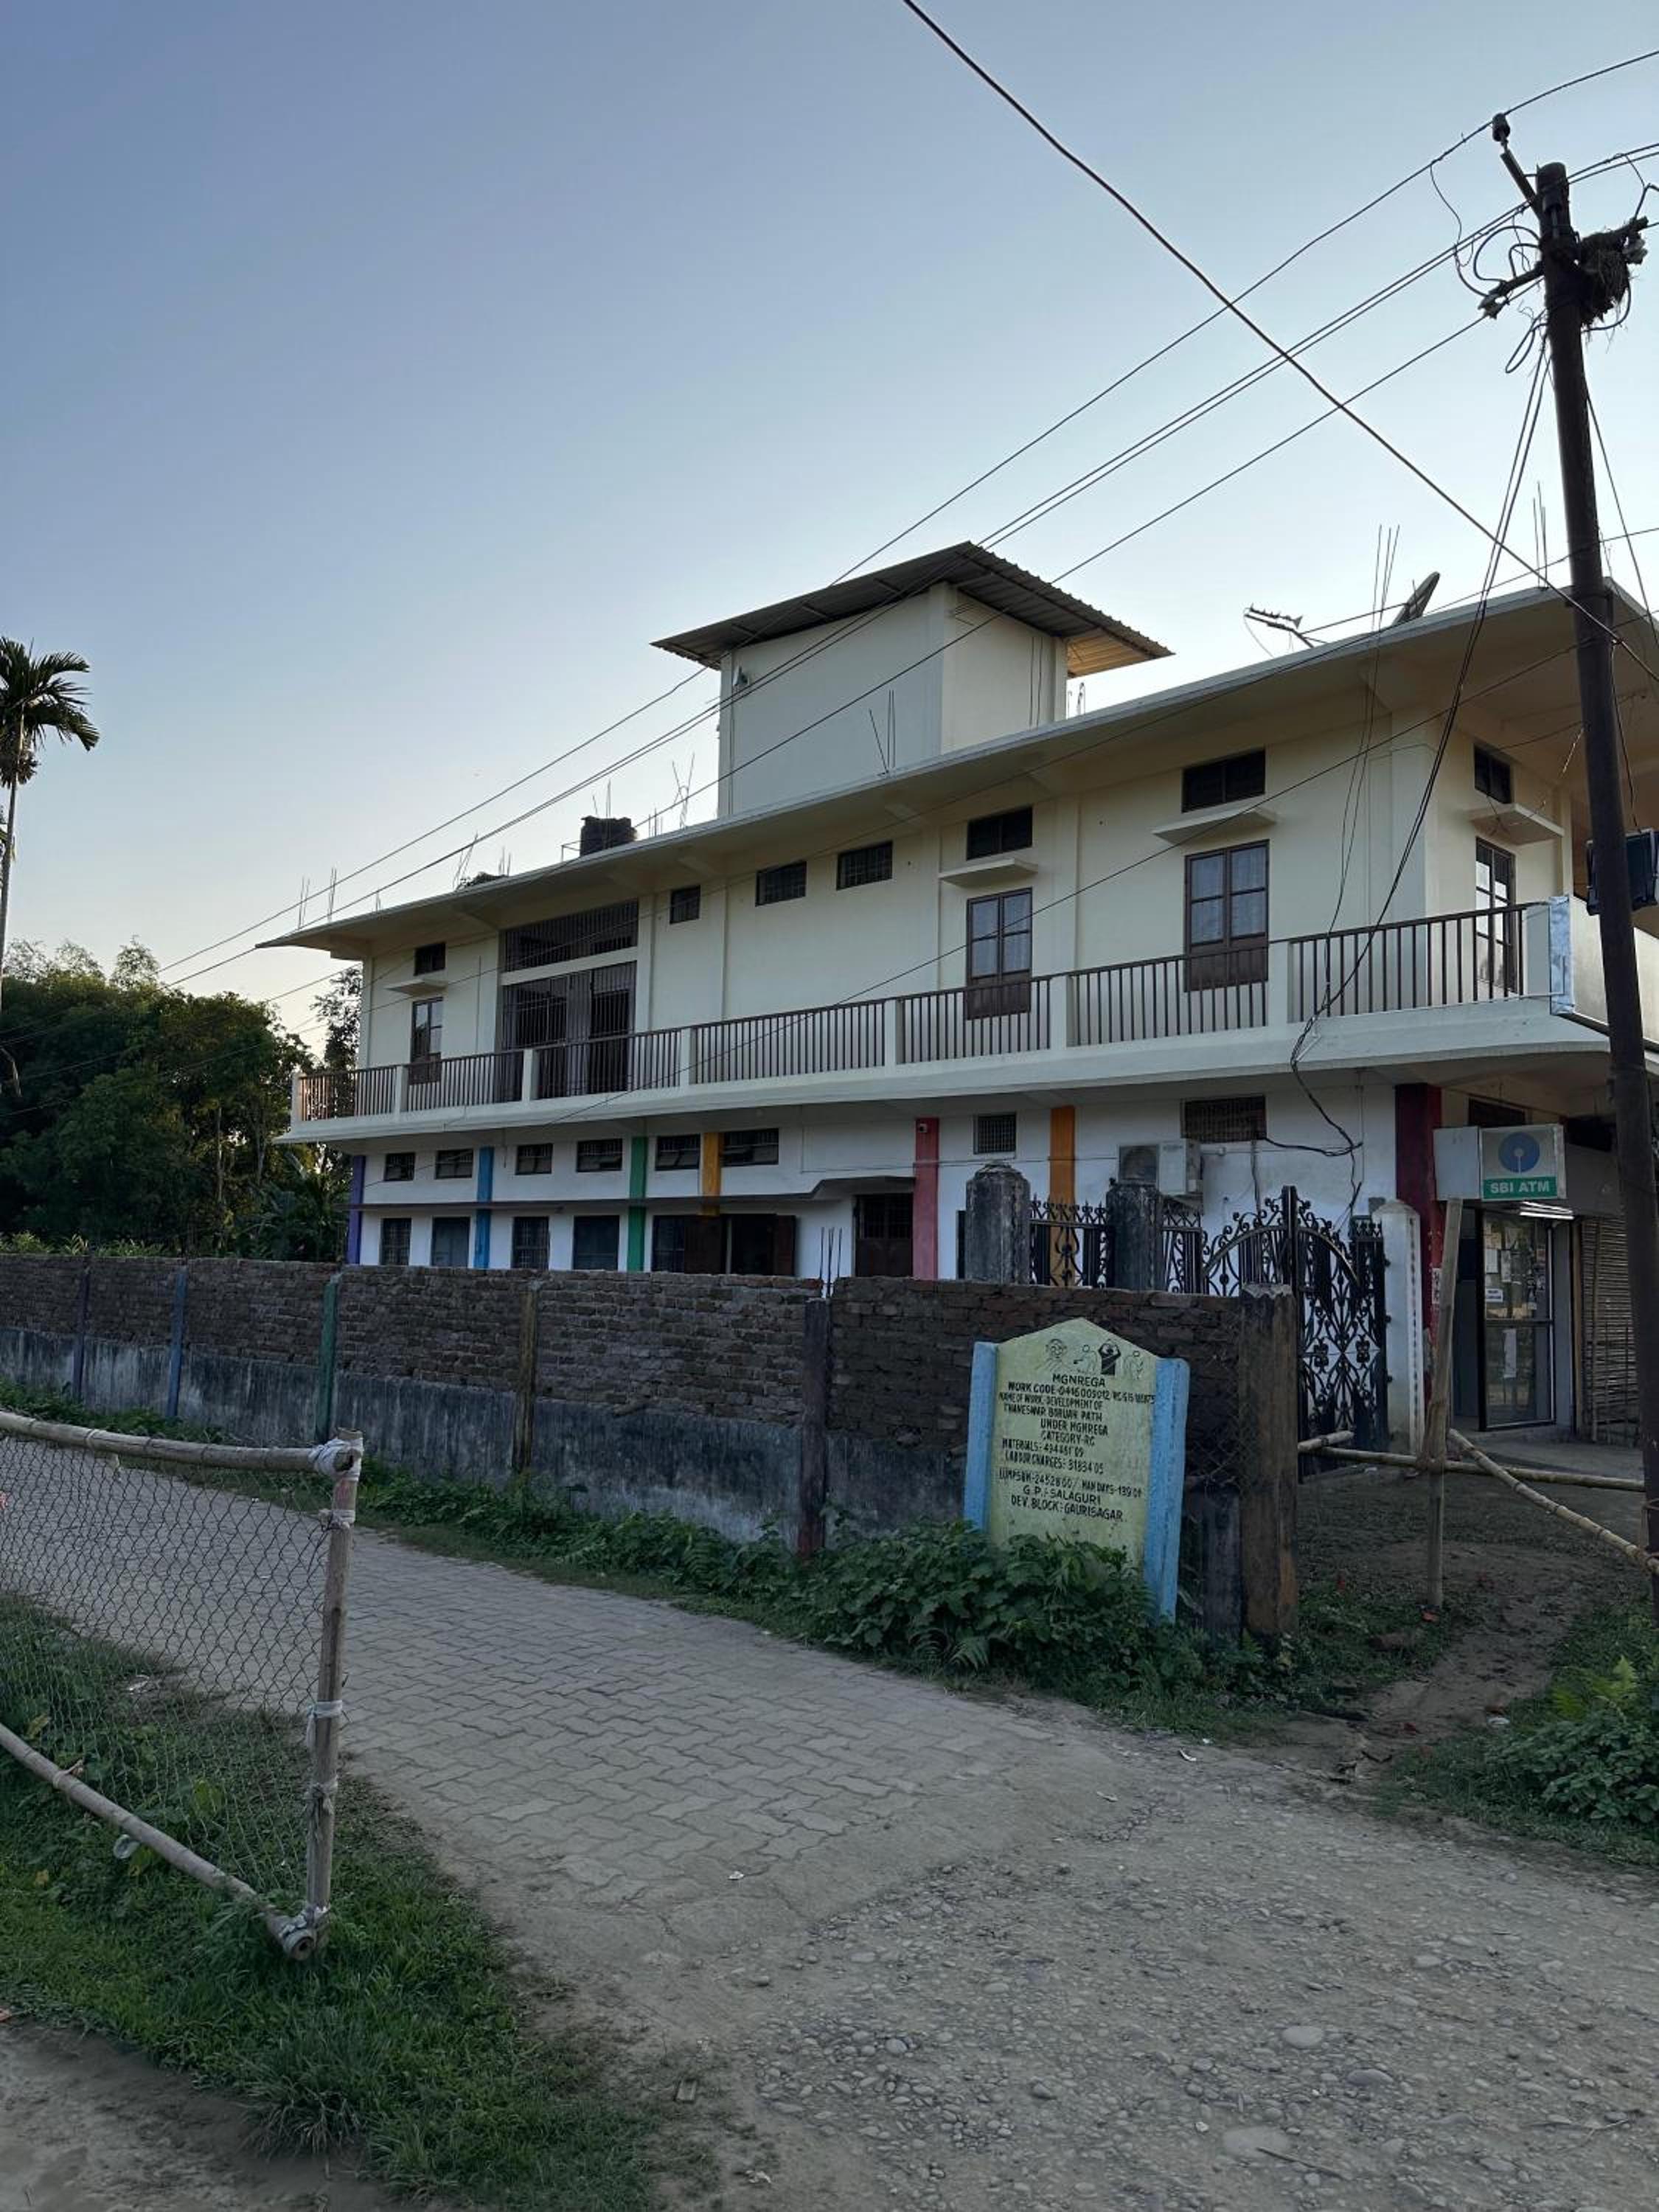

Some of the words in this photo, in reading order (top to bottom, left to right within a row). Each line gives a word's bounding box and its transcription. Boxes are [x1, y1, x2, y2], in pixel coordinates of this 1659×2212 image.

[1490, 1182, 1514, 1194] SBI
[1519, 1181, 1549, 1193] ATM
[1009, 1382, 1032, 1392] WORK
[1052, 1374, 1105, 1387] MGNREGA
[999, 1392, 1015, 1402] NAME
[1094, 1400, 1103, 1411] OF
[1082, 1411, 1102, 1422] PATH
[1041, 1418, 1067, 1430] UNDER
[1071, 1422, 1108, 1436] MGNREGA
